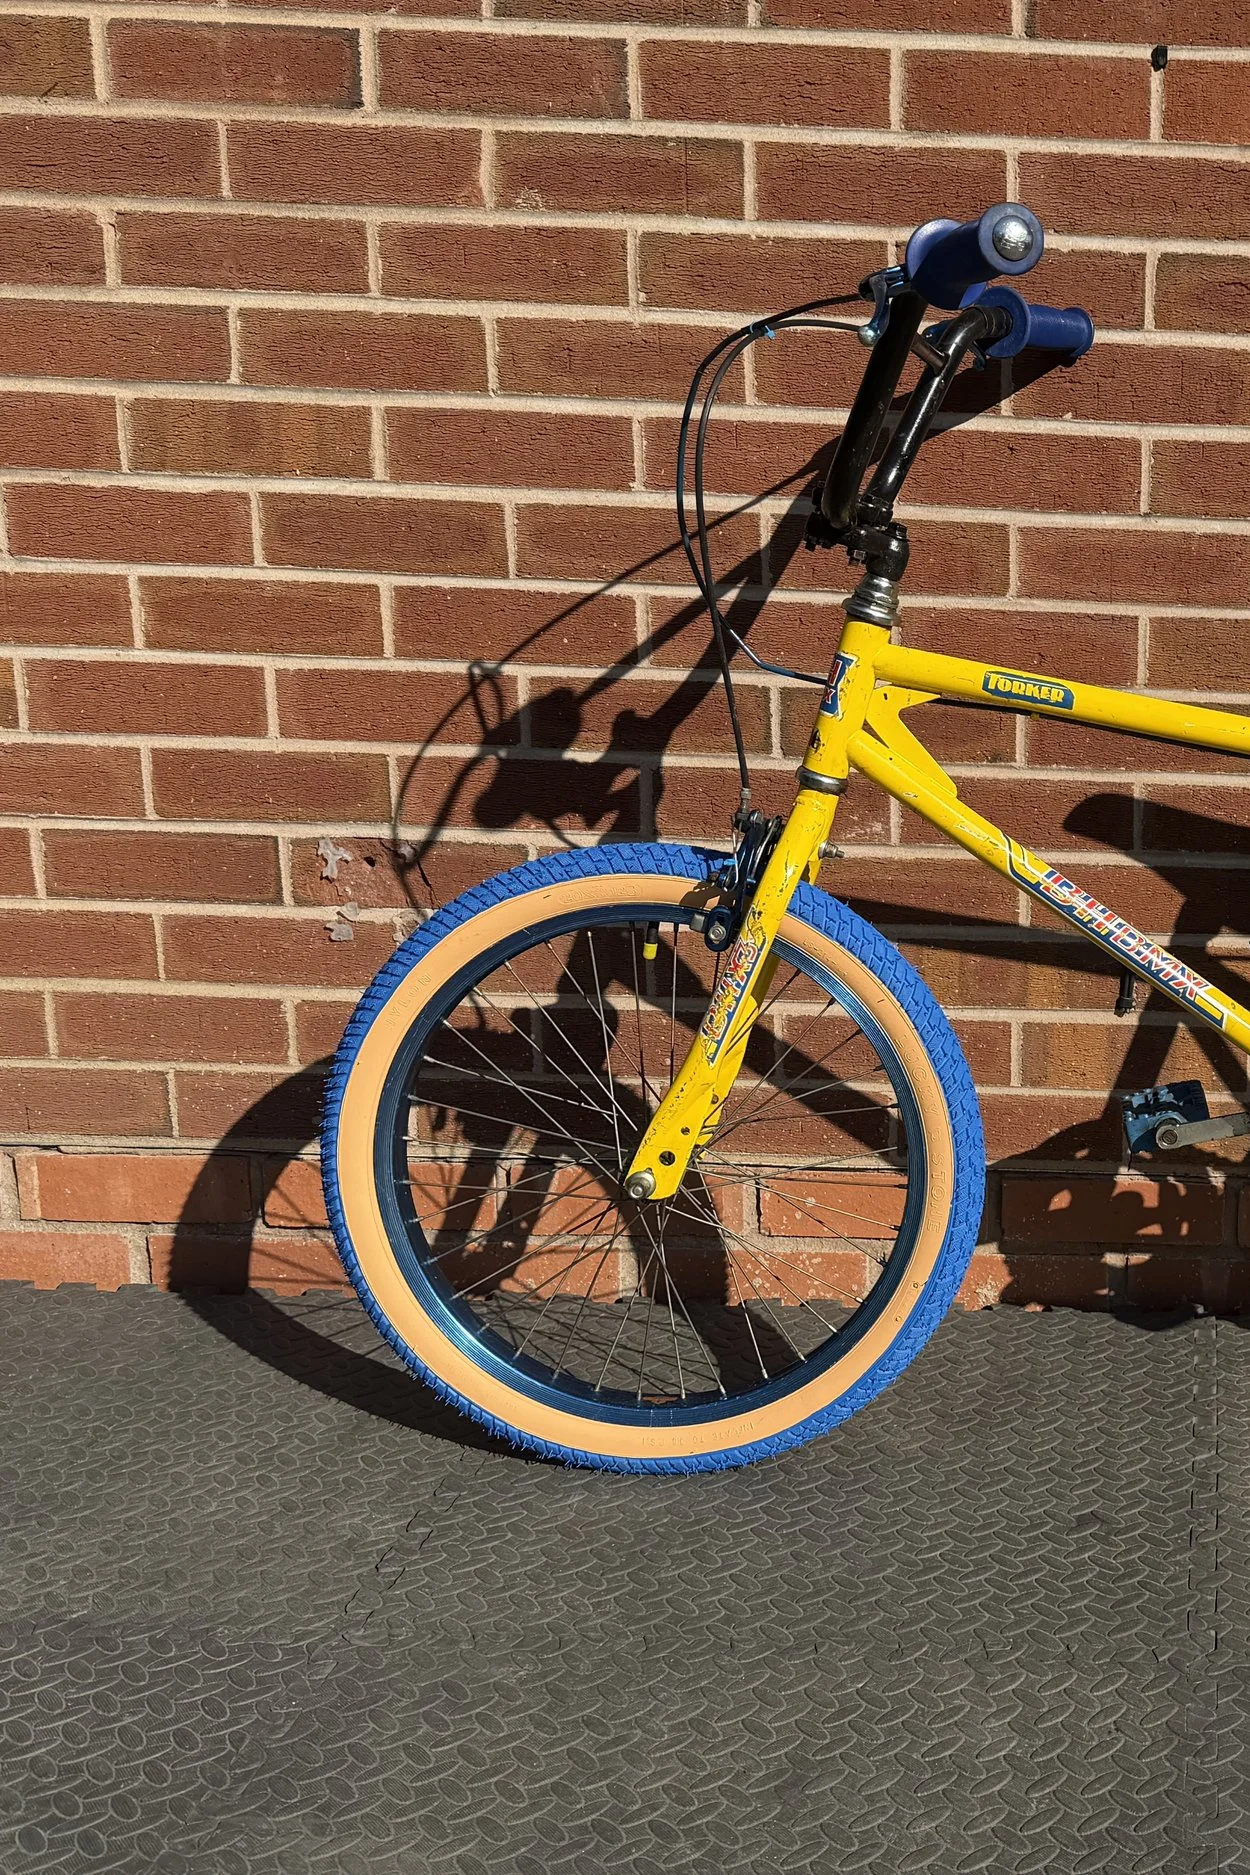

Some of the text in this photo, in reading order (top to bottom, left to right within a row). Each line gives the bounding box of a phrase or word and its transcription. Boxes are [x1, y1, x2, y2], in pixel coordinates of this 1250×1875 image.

[987, 673, 1065, 703] TORKER
[381, 969, 434, 1031] NYLON
[894, 1033, 946, 1234] LUCKY STONE
